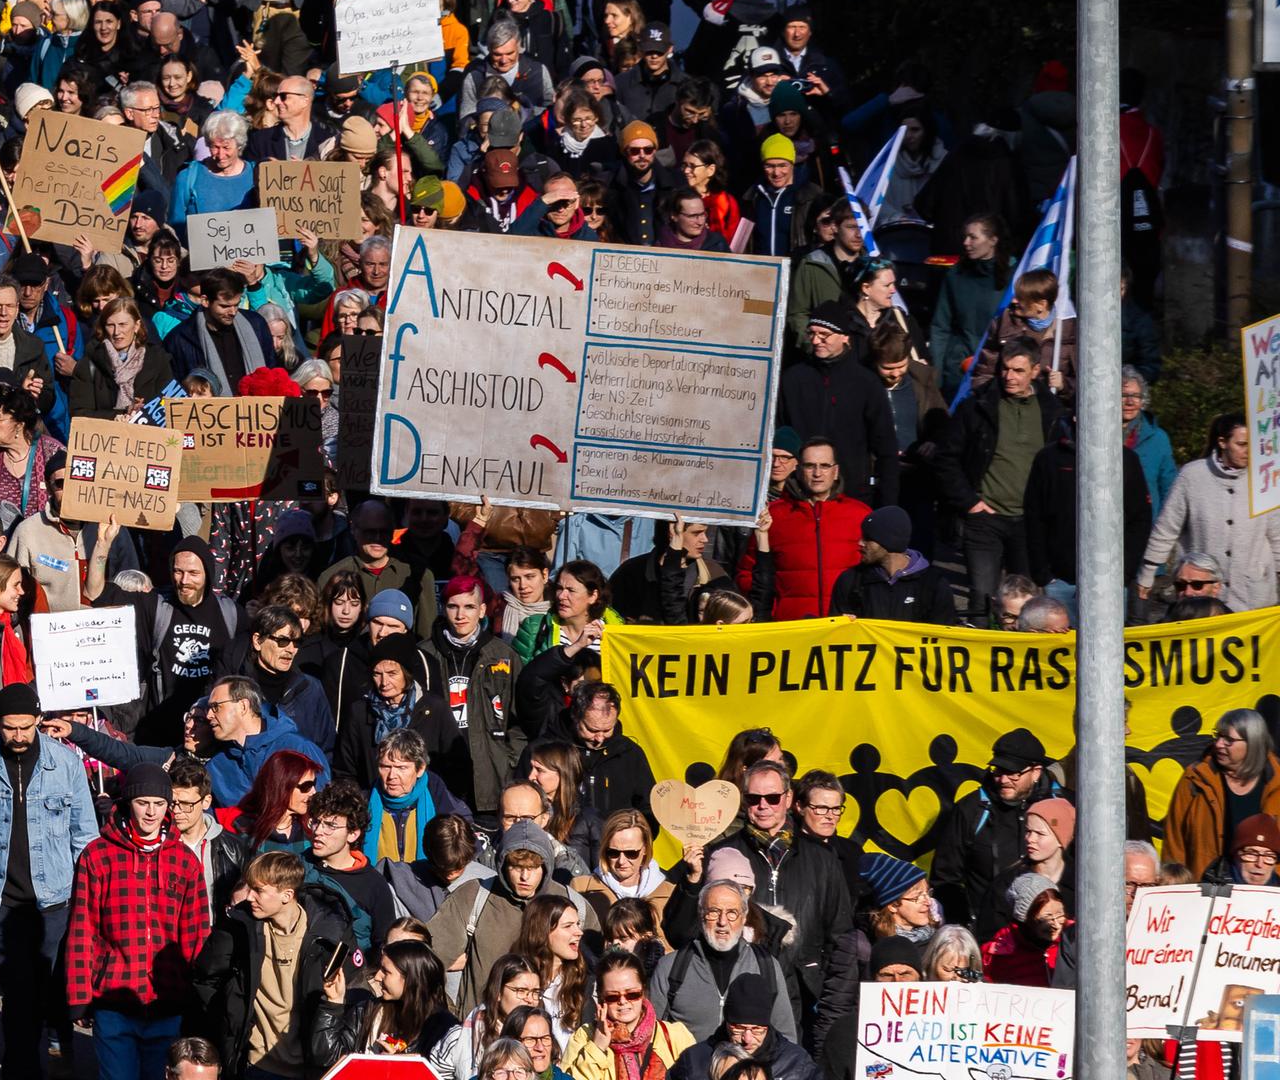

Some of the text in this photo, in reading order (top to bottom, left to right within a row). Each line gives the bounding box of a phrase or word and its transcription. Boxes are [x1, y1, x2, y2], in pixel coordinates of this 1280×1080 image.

[372, 26, 414, 46] eigentlich
[35, 117, 119, 163] Nazis
[45, 161, 104, 181] essen
[300, 165, 315, 192] A
[310, 195, 343, 215] nicht
[214, 239, 265, 261] Mensch
[599, 274, 750, 300] Erhöhung des Mindestlohns
[598, 293, 677, 314] Reichensteuer
[597, 315, 703, 339] Erbschaftssteuer
[591, 351, 640, 369] völkische
[588, 389, 604, 402] der
[676, 379, 757, 411] Verharmlosung
[586, 407, 711, 430] Geschichtsrevisionismus
[125, 438, 167, 462] WEED
[582, 448, 714, 470] ignorieren Klimawandels
[101, 461, 140, 483] AND
[78, 485, 166, 514] HATE NAZIS
[49, 622, 66, 632] Nie
[174, 623, 211, 638] GEGEN
[630, 637, 975, 698] KEIN PLATZ FÜR
[1146, 904, 1176, 934] Wir
[1155, 943, 1193, 965] einen
[881, 987, 948, 1017] NEIN
[865, 1021, 903, 1046] DIE
[950, 1022, 978, 1040] IST
[984, 1022, 1055, 1046] KEINE
